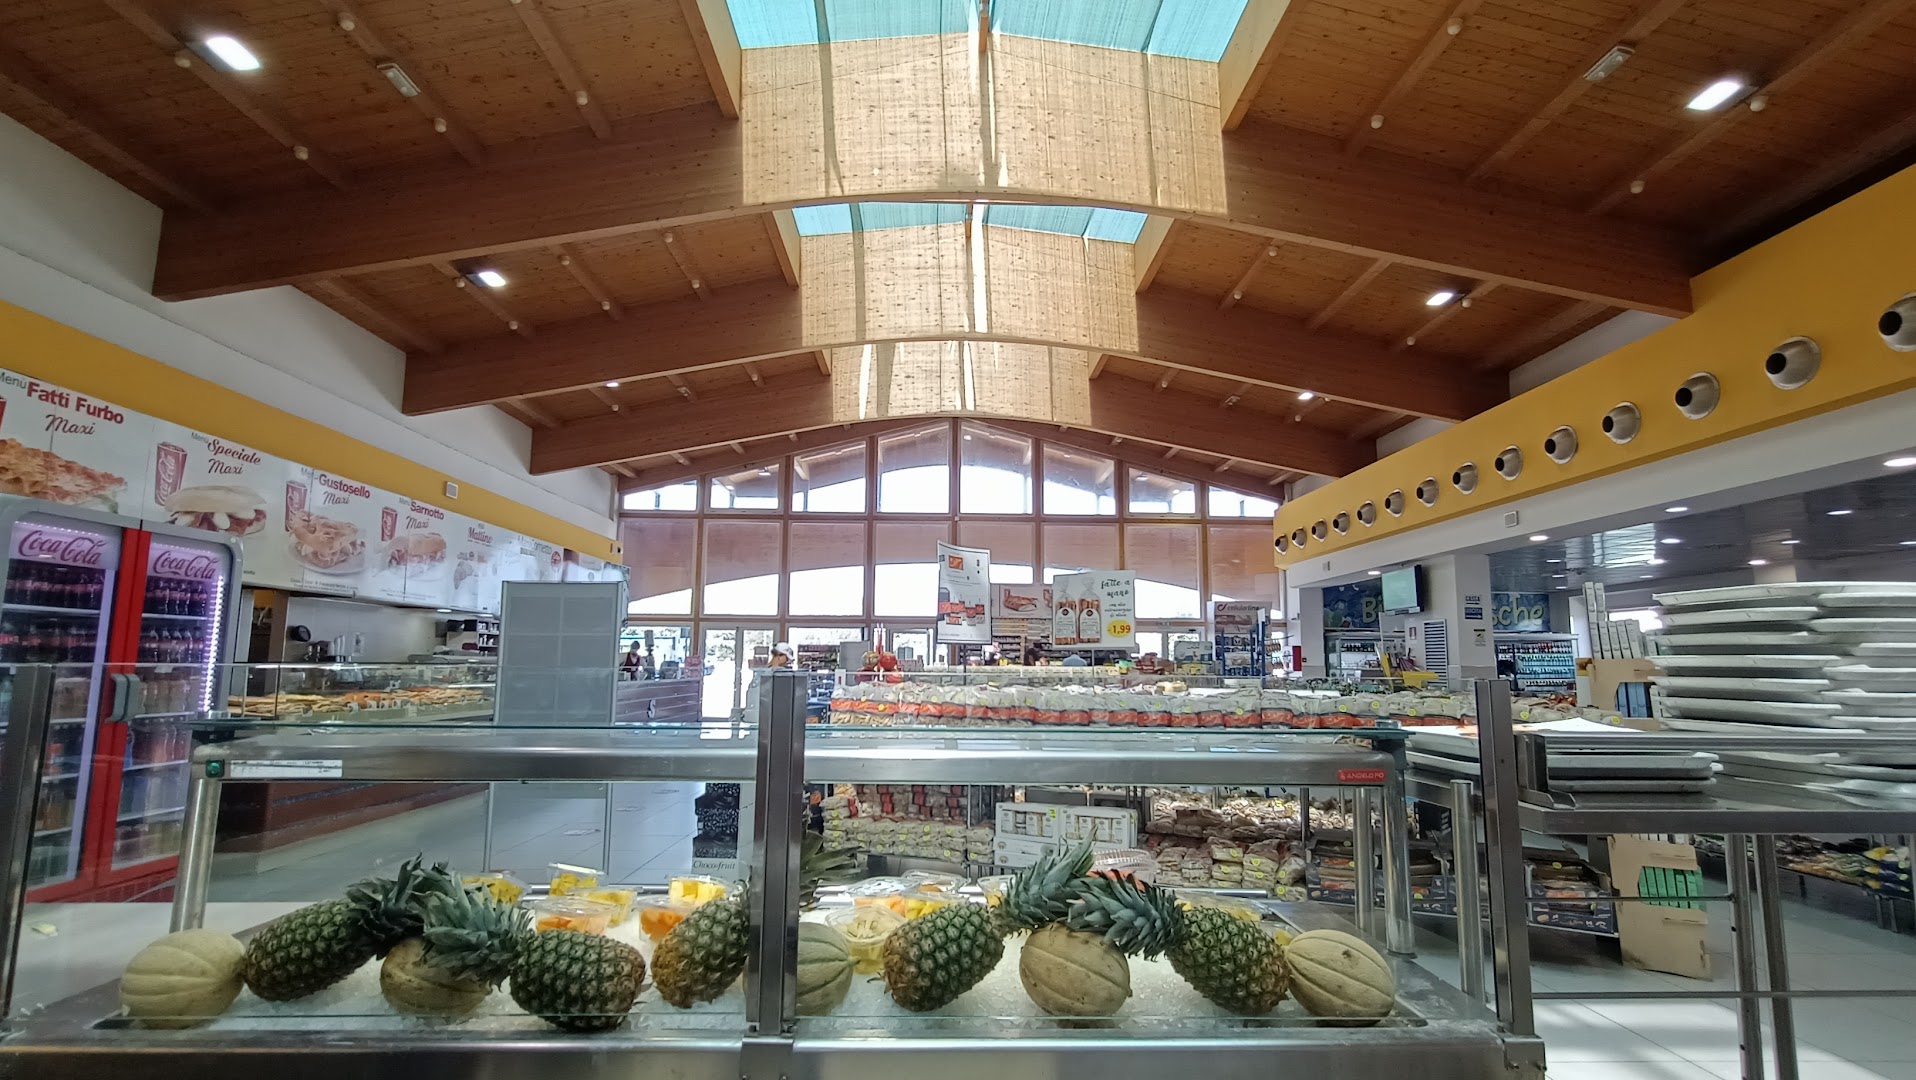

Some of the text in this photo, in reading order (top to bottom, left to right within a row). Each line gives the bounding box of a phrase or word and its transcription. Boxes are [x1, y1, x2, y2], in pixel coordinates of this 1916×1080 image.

[27, 381, 125, 424] Fatti Furbo
[45, 414, 96, 435] Maxi
[208, 438, 261, 466] Speciale
[208, 458, 244, 475] Maxi
[319, 473, 371, 499] Gustosello
[323, 490, 351, 505] Maxi
[410, 501, 445, 520] Sarnotto
[153, 550, 220, 580] Coca-Cola
[1101, 578, 1121, 589] fatte
